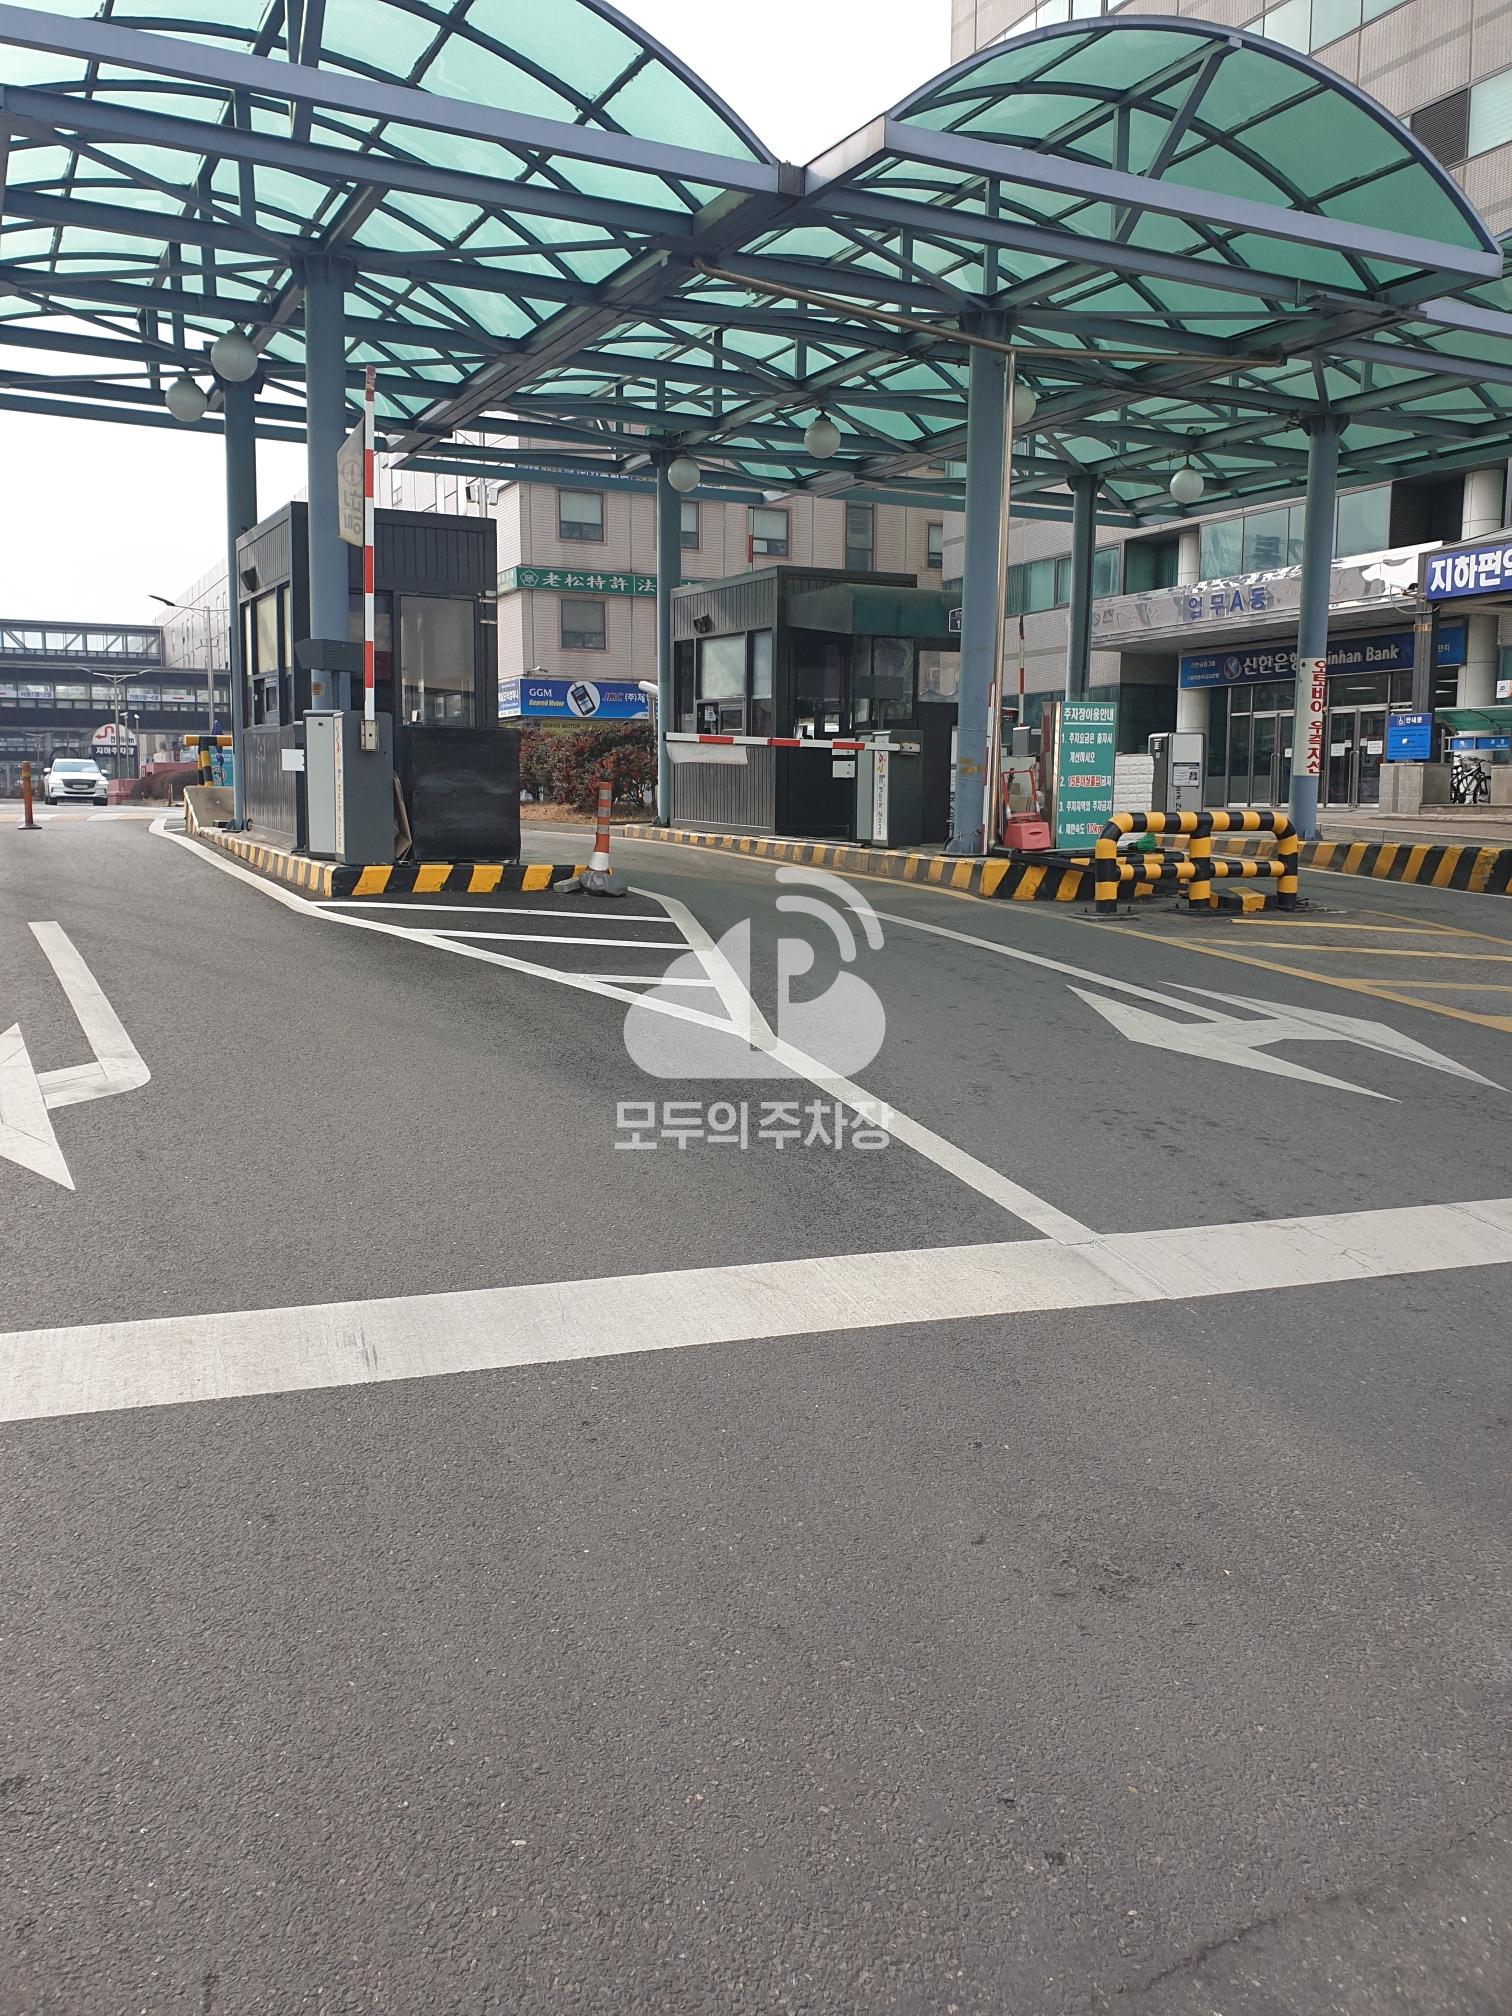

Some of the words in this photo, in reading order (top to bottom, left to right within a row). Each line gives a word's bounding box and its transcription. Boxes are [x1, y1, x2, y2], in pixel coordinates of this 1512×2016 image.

[542, 572, 629, 592] 老松特許
[1326, 651, 1361, 666] inhan
[1366, 644, 1399, 662] Bank
[529, 688, 552, 698] GGM
[602, 692, 624, 702] JMC
